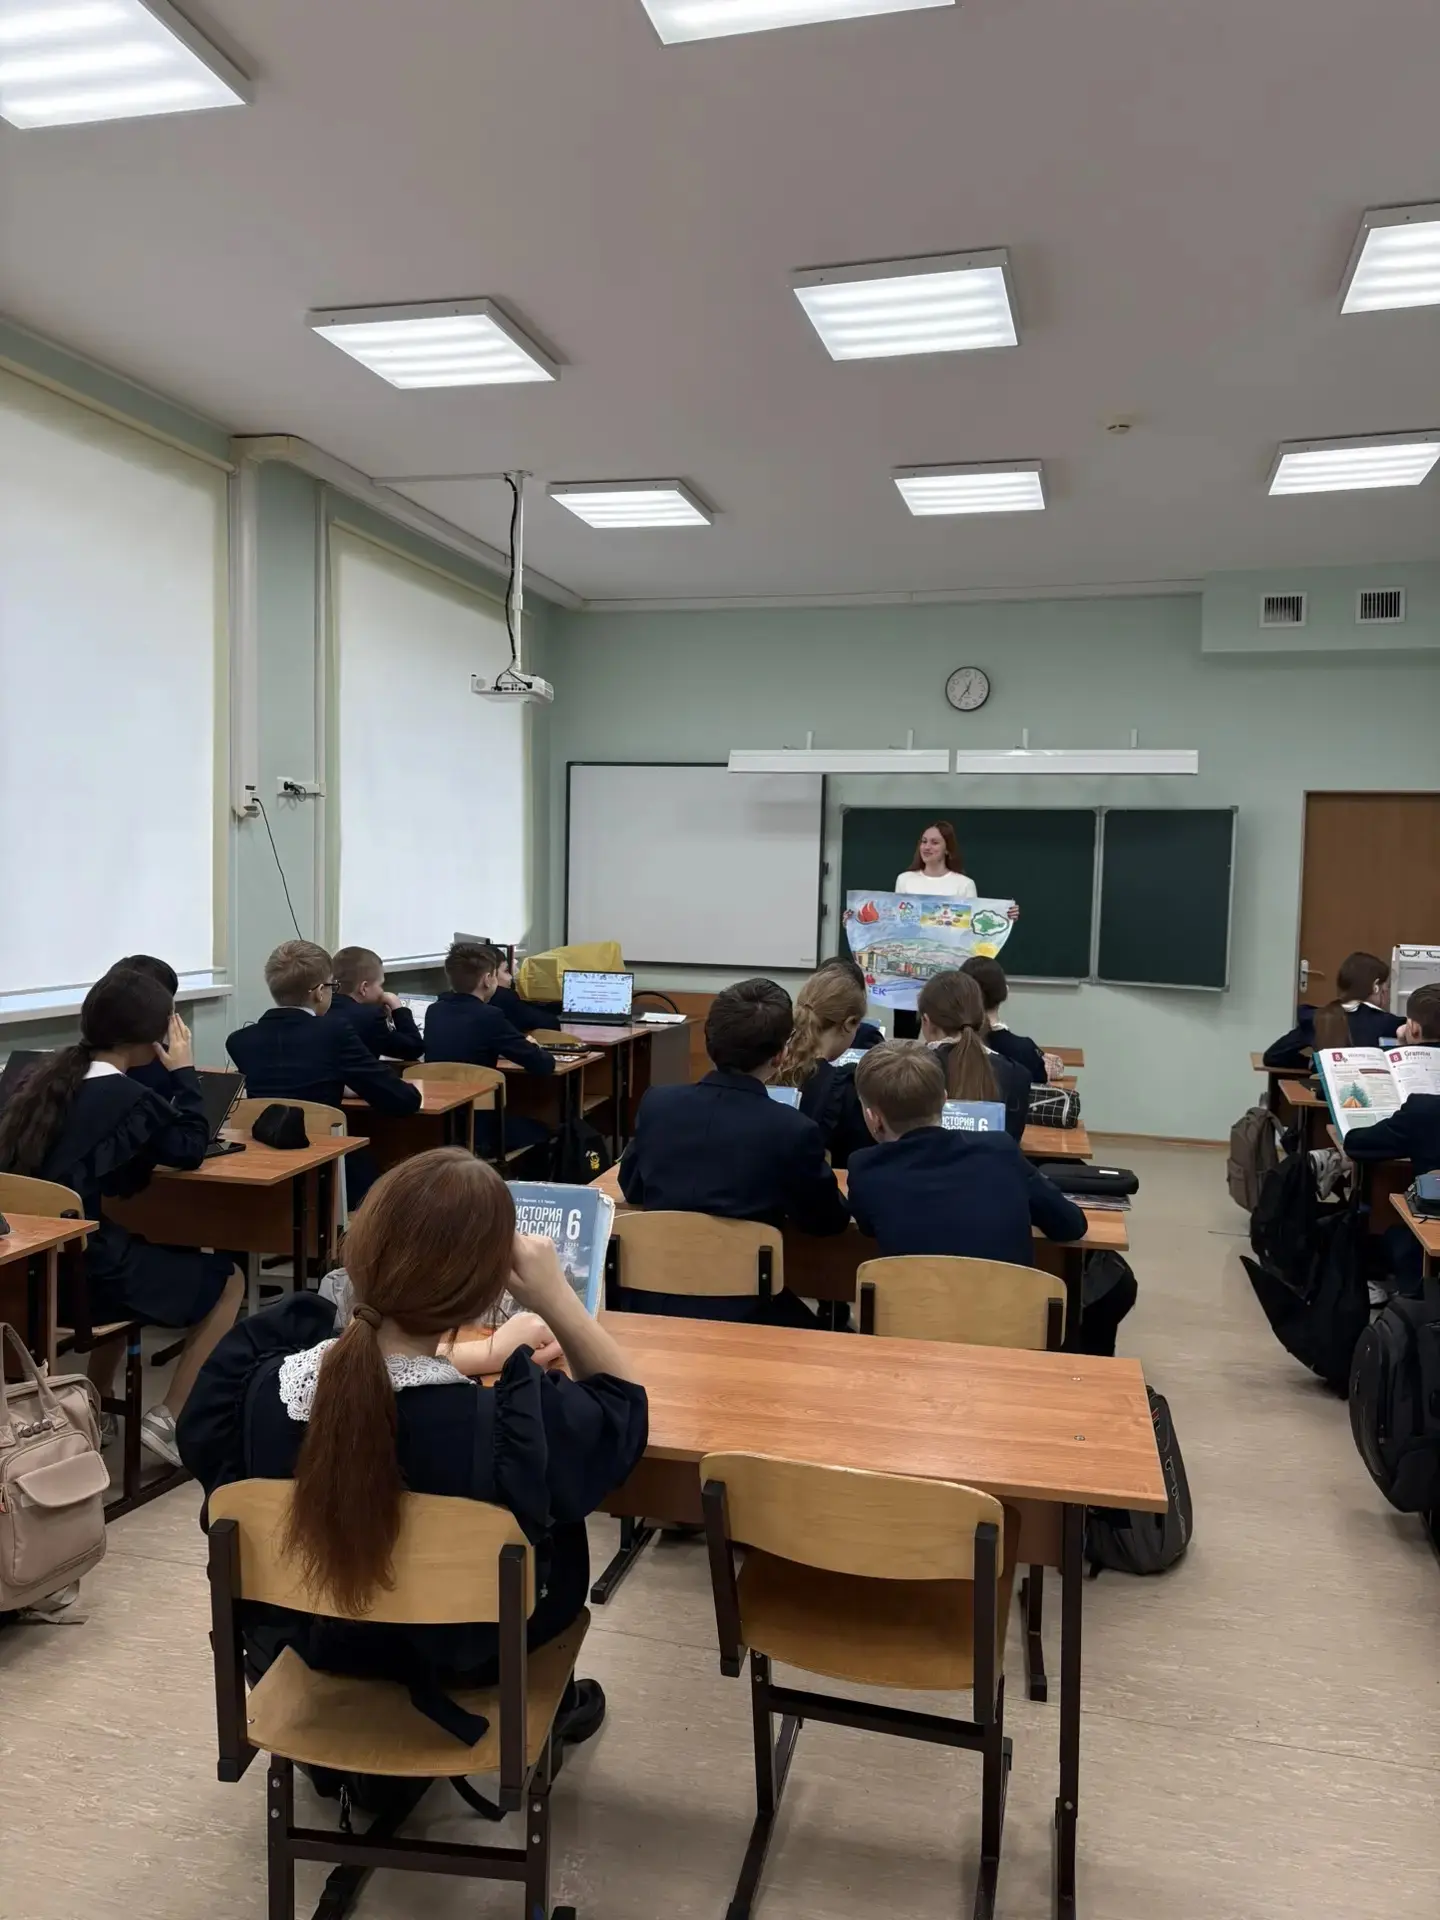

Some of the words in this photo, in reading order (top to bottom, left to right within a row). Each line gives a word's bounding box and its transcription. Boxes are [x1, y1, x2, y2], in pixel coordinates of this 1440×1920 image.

[978, 1118, 988, 1131] 6
[515, 1205, 563, 1222] ИСТОРИЯ
[566, 1208, 582, 1240] 6
